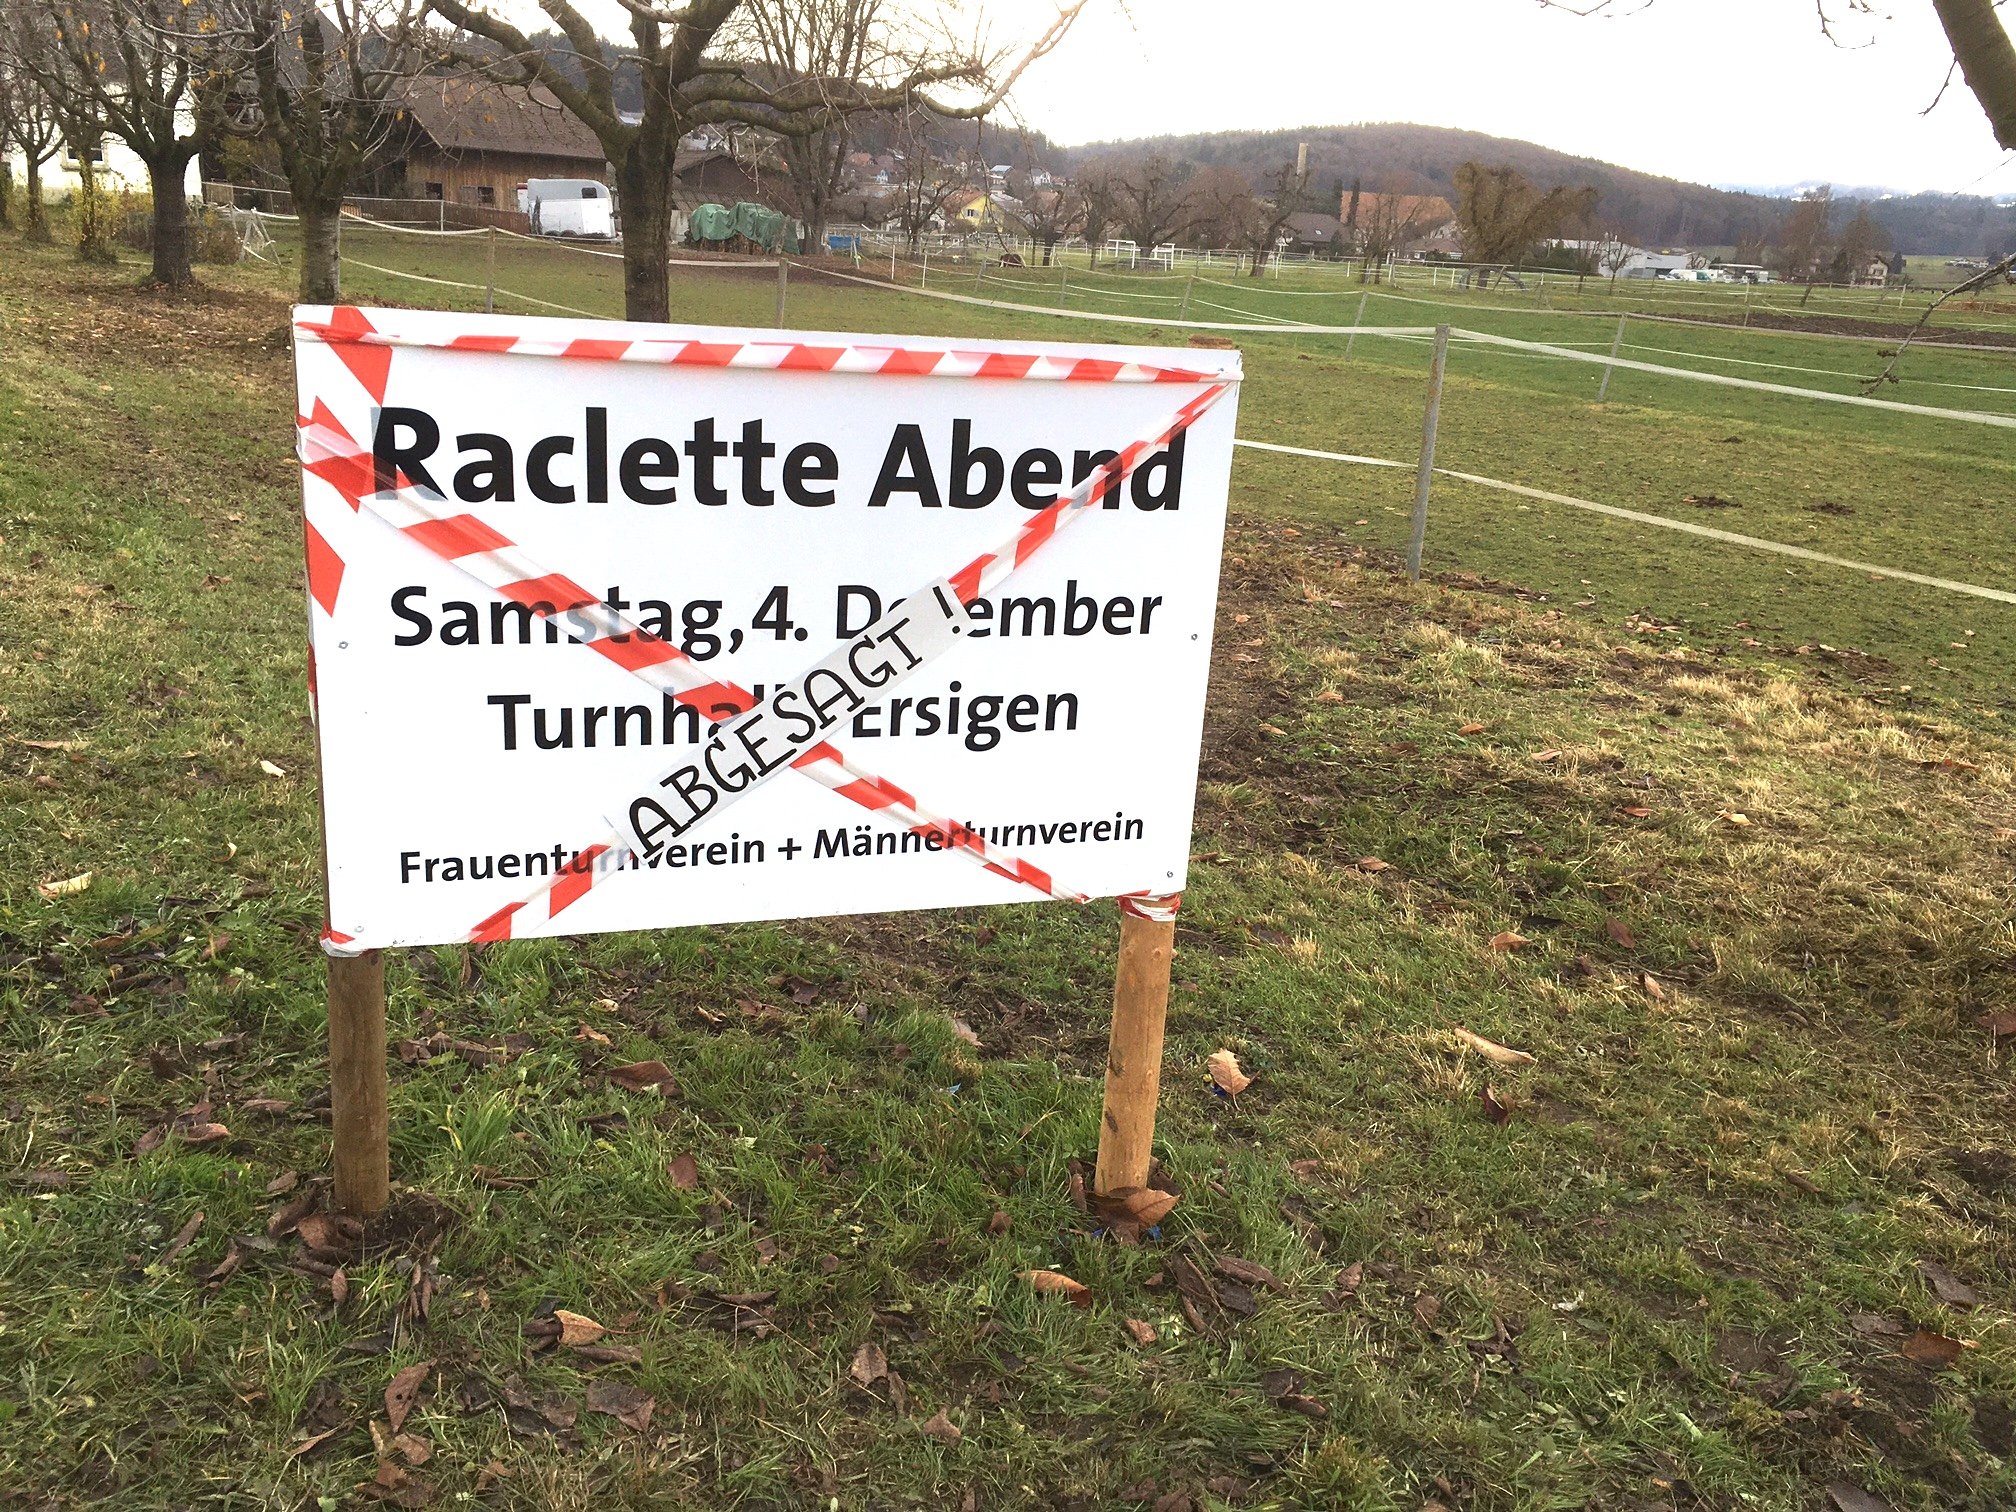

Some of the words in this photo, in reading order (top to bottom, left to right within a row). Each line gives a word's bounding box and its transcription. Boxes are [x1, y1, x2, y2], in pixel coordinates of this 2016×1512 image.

[370, 406, 839, 507] Raclette
[867, 418, 1187, 511] Abend
[629, 617, 923, 859] ABGESAGT
